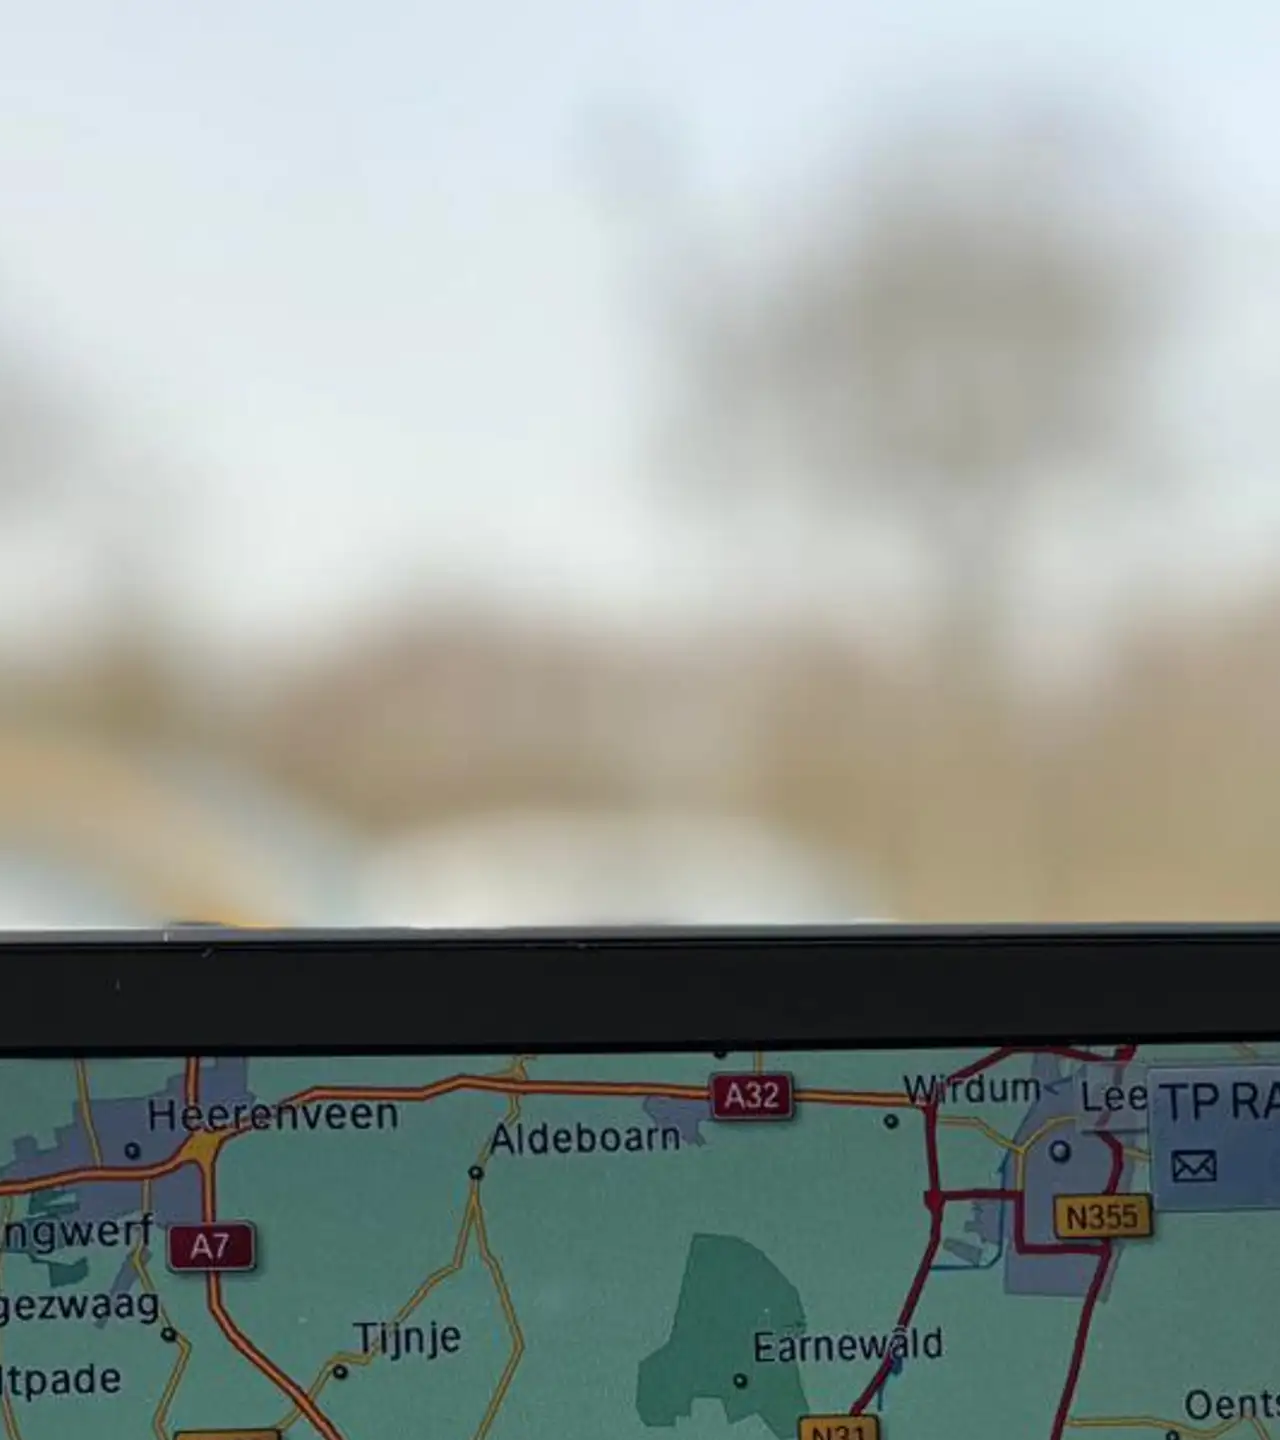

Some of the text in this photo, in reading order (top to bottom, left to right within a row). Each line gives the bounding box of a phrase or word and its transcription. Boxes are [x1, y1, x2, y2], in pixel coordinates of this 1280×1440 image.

[725, 1081, 780, 1109] A32
[903, 1075, 1040, 1104] Wirdum
[1082, 1081, 1148, 1112] Lee
[148, 1100, 399, 1132] Heerenveen
[490, 1121, 680, 1154] Aldeboarn
[1066, 1202, 1139, 1230] N355
[190, 1232, 230, 1261] A7
[353, 1321, 462, 1361] Tijnje
[754, 1326, 943, 1363] Earnewâld
